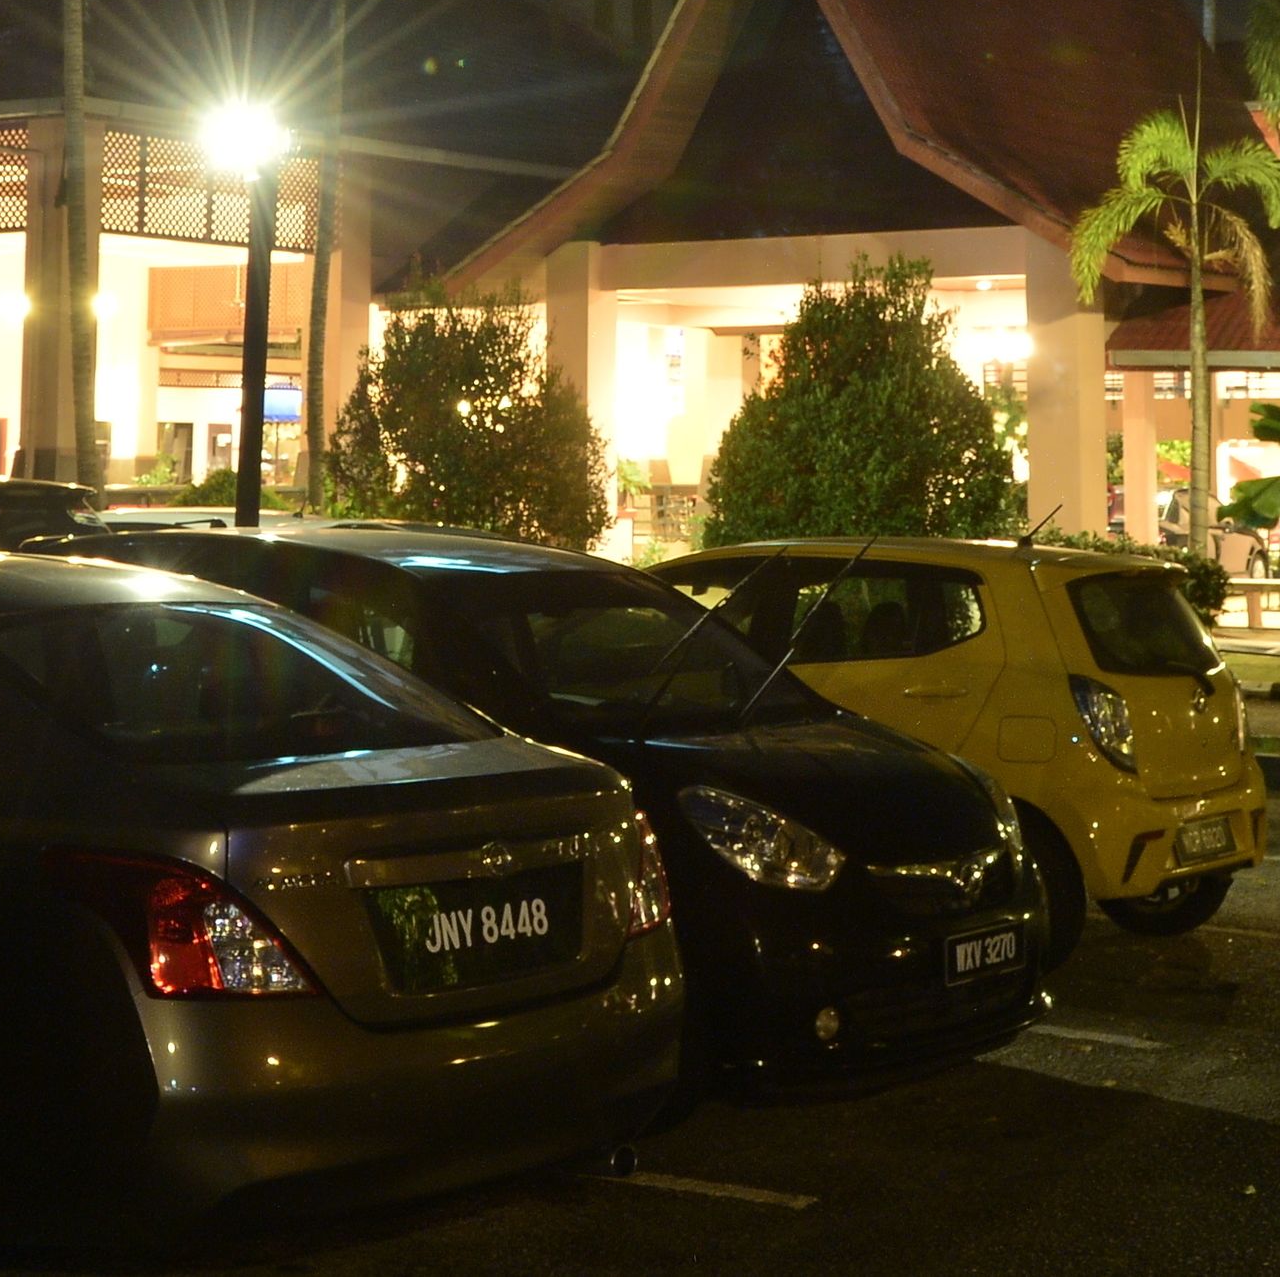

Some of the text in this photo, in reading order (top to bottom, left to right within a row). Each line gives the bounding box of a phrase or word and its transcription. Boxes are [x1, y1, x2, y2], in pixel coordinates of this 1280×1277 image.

[425, 898, 549, 953] JNY 8448
[985, 932, 1016, 964] 3270
